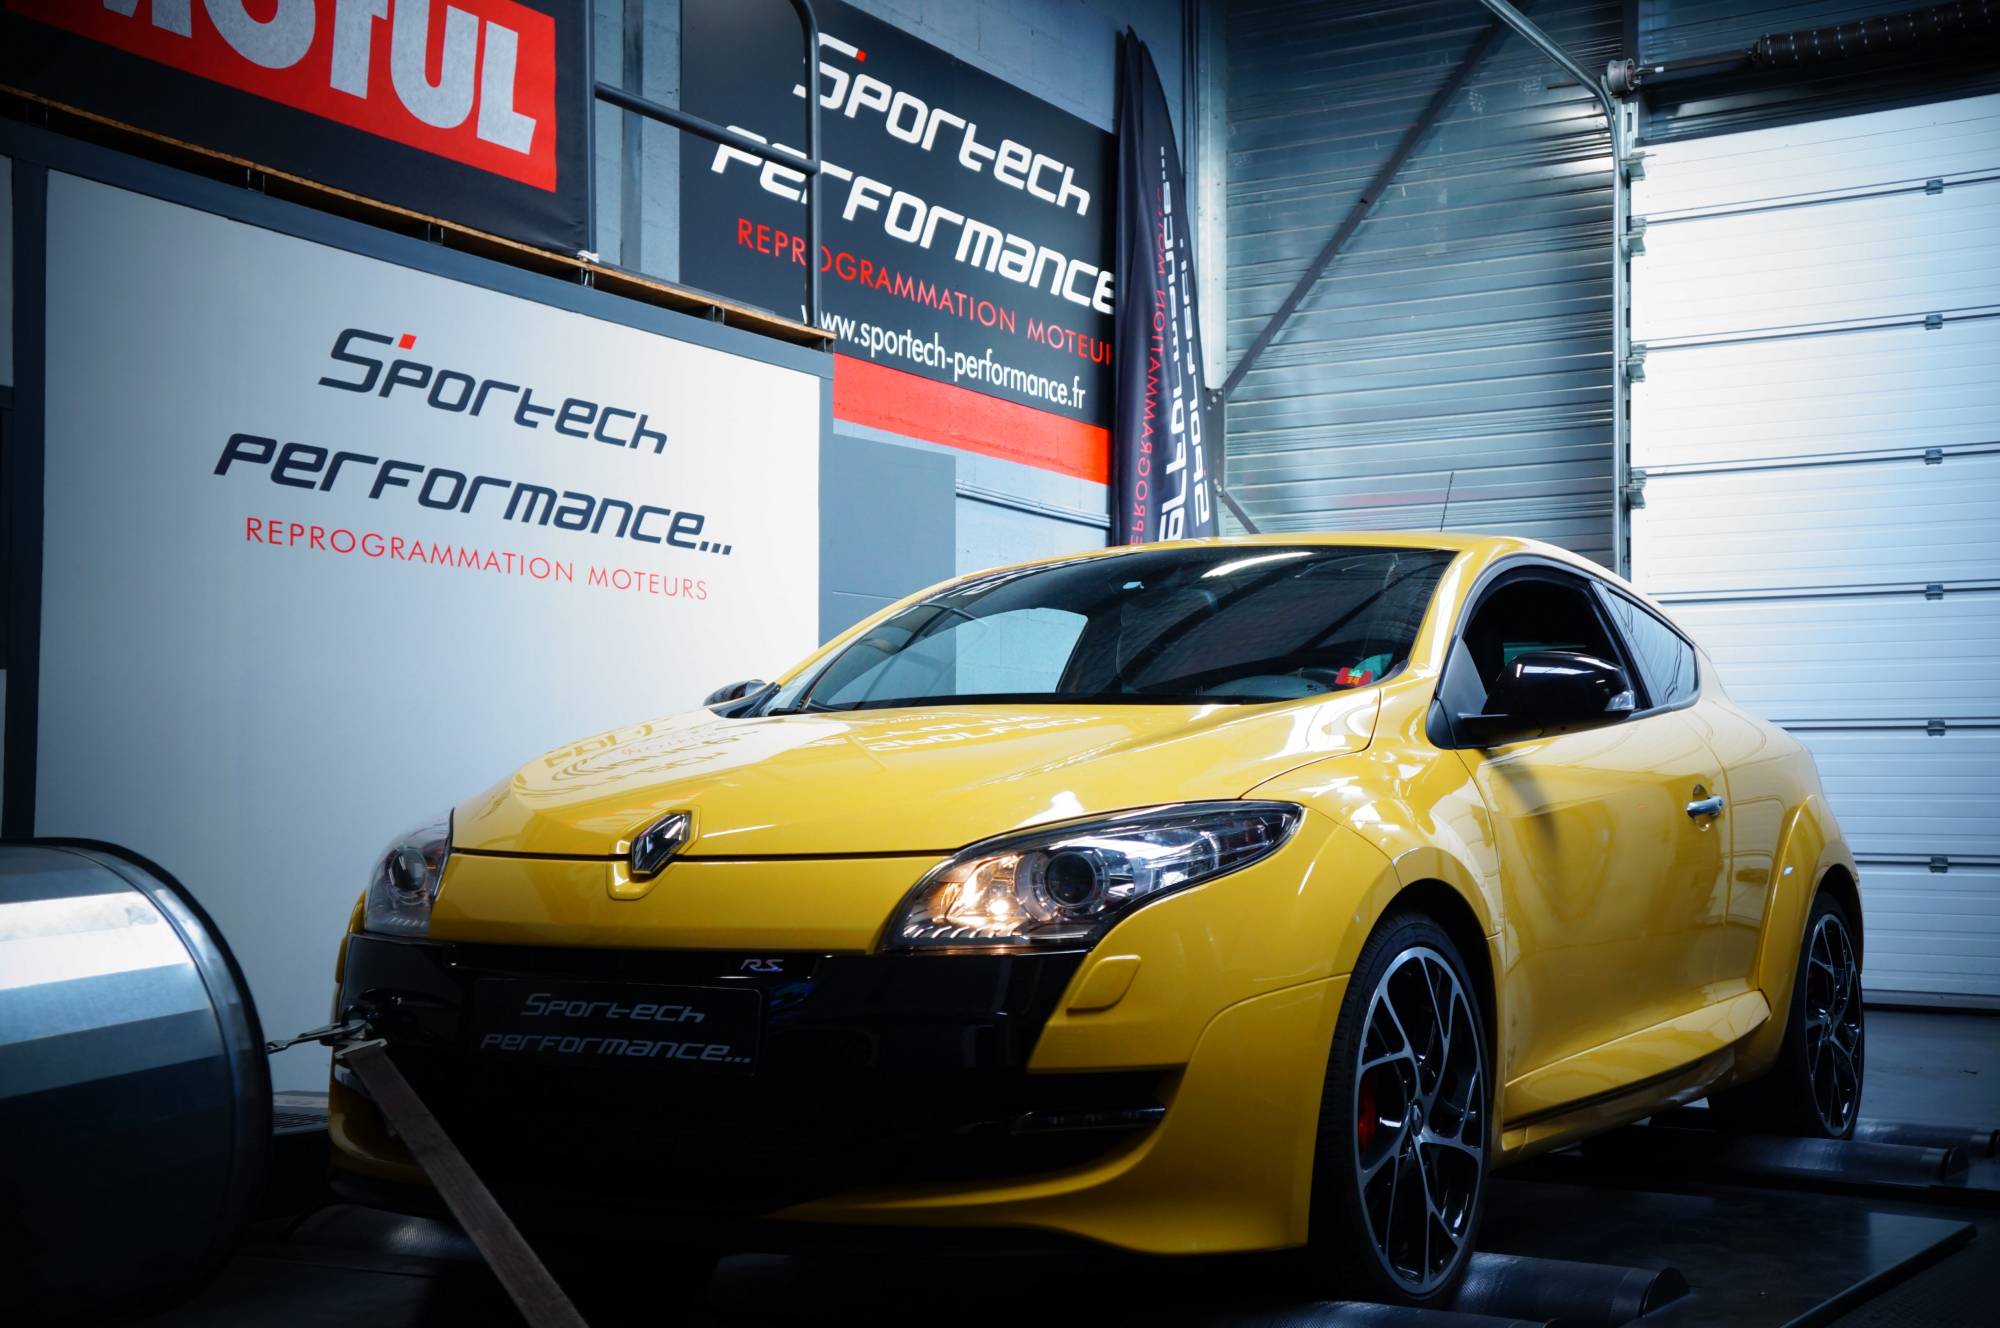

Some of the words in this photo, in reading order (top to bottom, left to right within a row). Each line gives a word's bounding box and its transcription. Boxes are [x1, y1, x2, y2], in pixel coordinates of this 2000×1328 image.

[102, 0, 537, 155] OTUL
[801, 304, 1086, 409] ww.sportech-performance.fr
[1026, 318, 1112, 366] MOTEU
[317, 328, 668, 454] Sportech
[246, 517, 574, 583] REPROGRAMMATION
[588, 565, 708, 601] MOTEURS
[740, 958, 784, 972] RS
[520, 993, 706, 1023] Sportech
